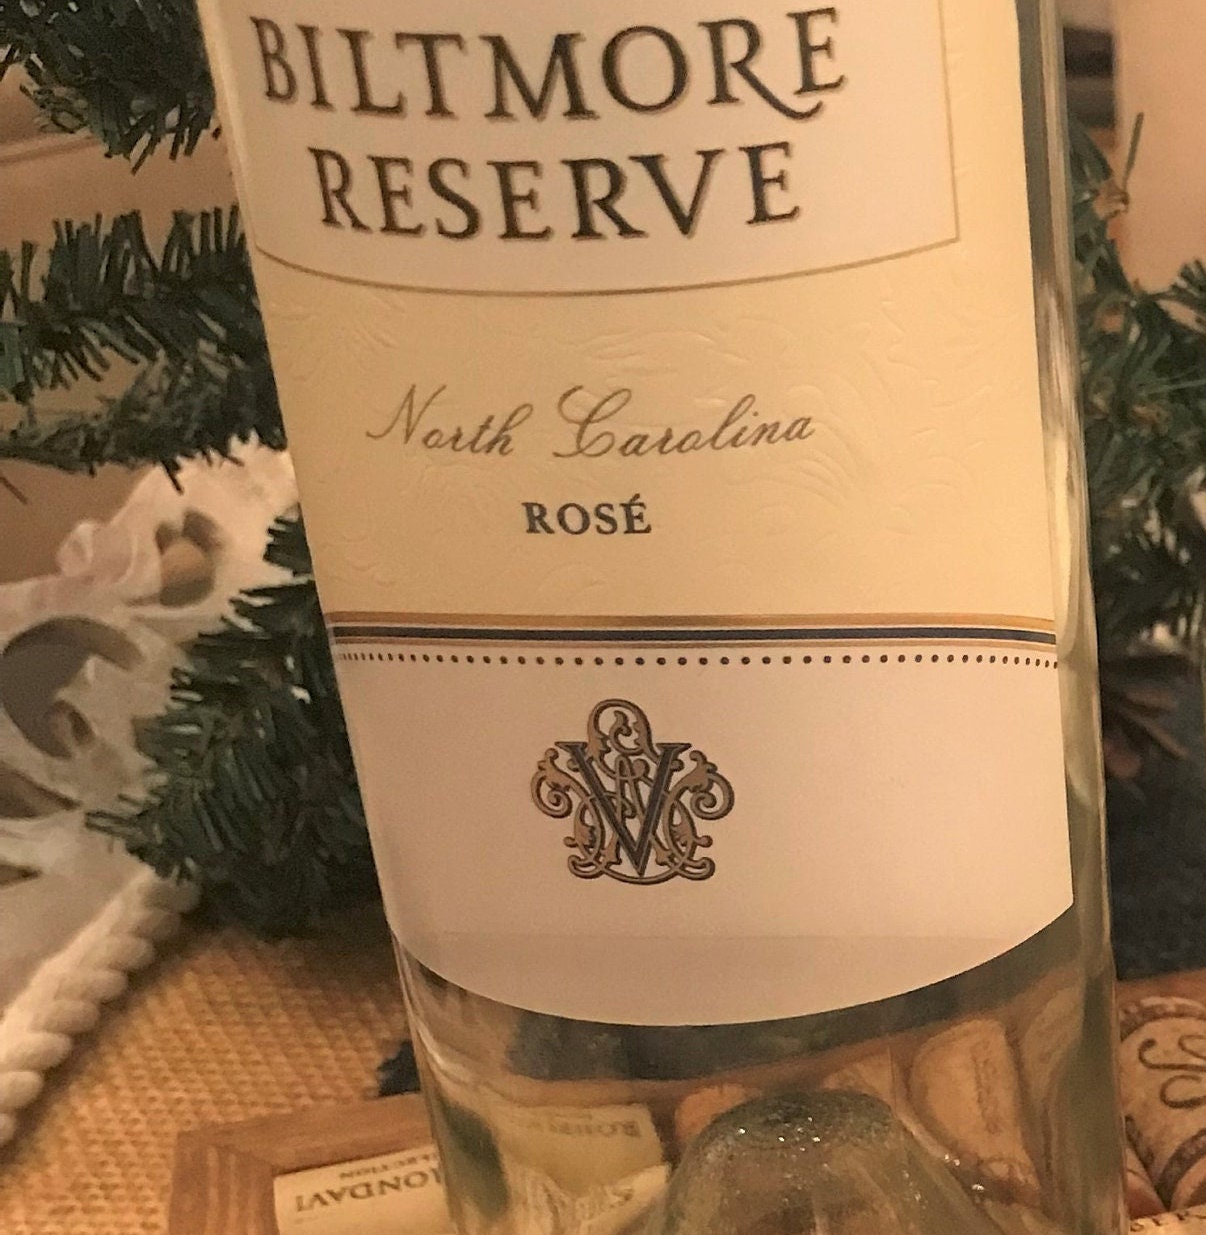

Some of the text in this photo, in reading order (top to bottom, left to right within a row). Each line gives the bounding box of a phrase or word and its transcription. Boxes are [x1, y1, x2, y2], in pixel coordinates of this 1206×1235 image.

[250, 6, 847, 120] BILTMORE
[306, 140, 802, 241] RESERVE
[366, 383, 817, 460] North Carolina
[521, 493, 653, 535] ROSÉ
[294, 1166, 443, 1213] ONDAVI
